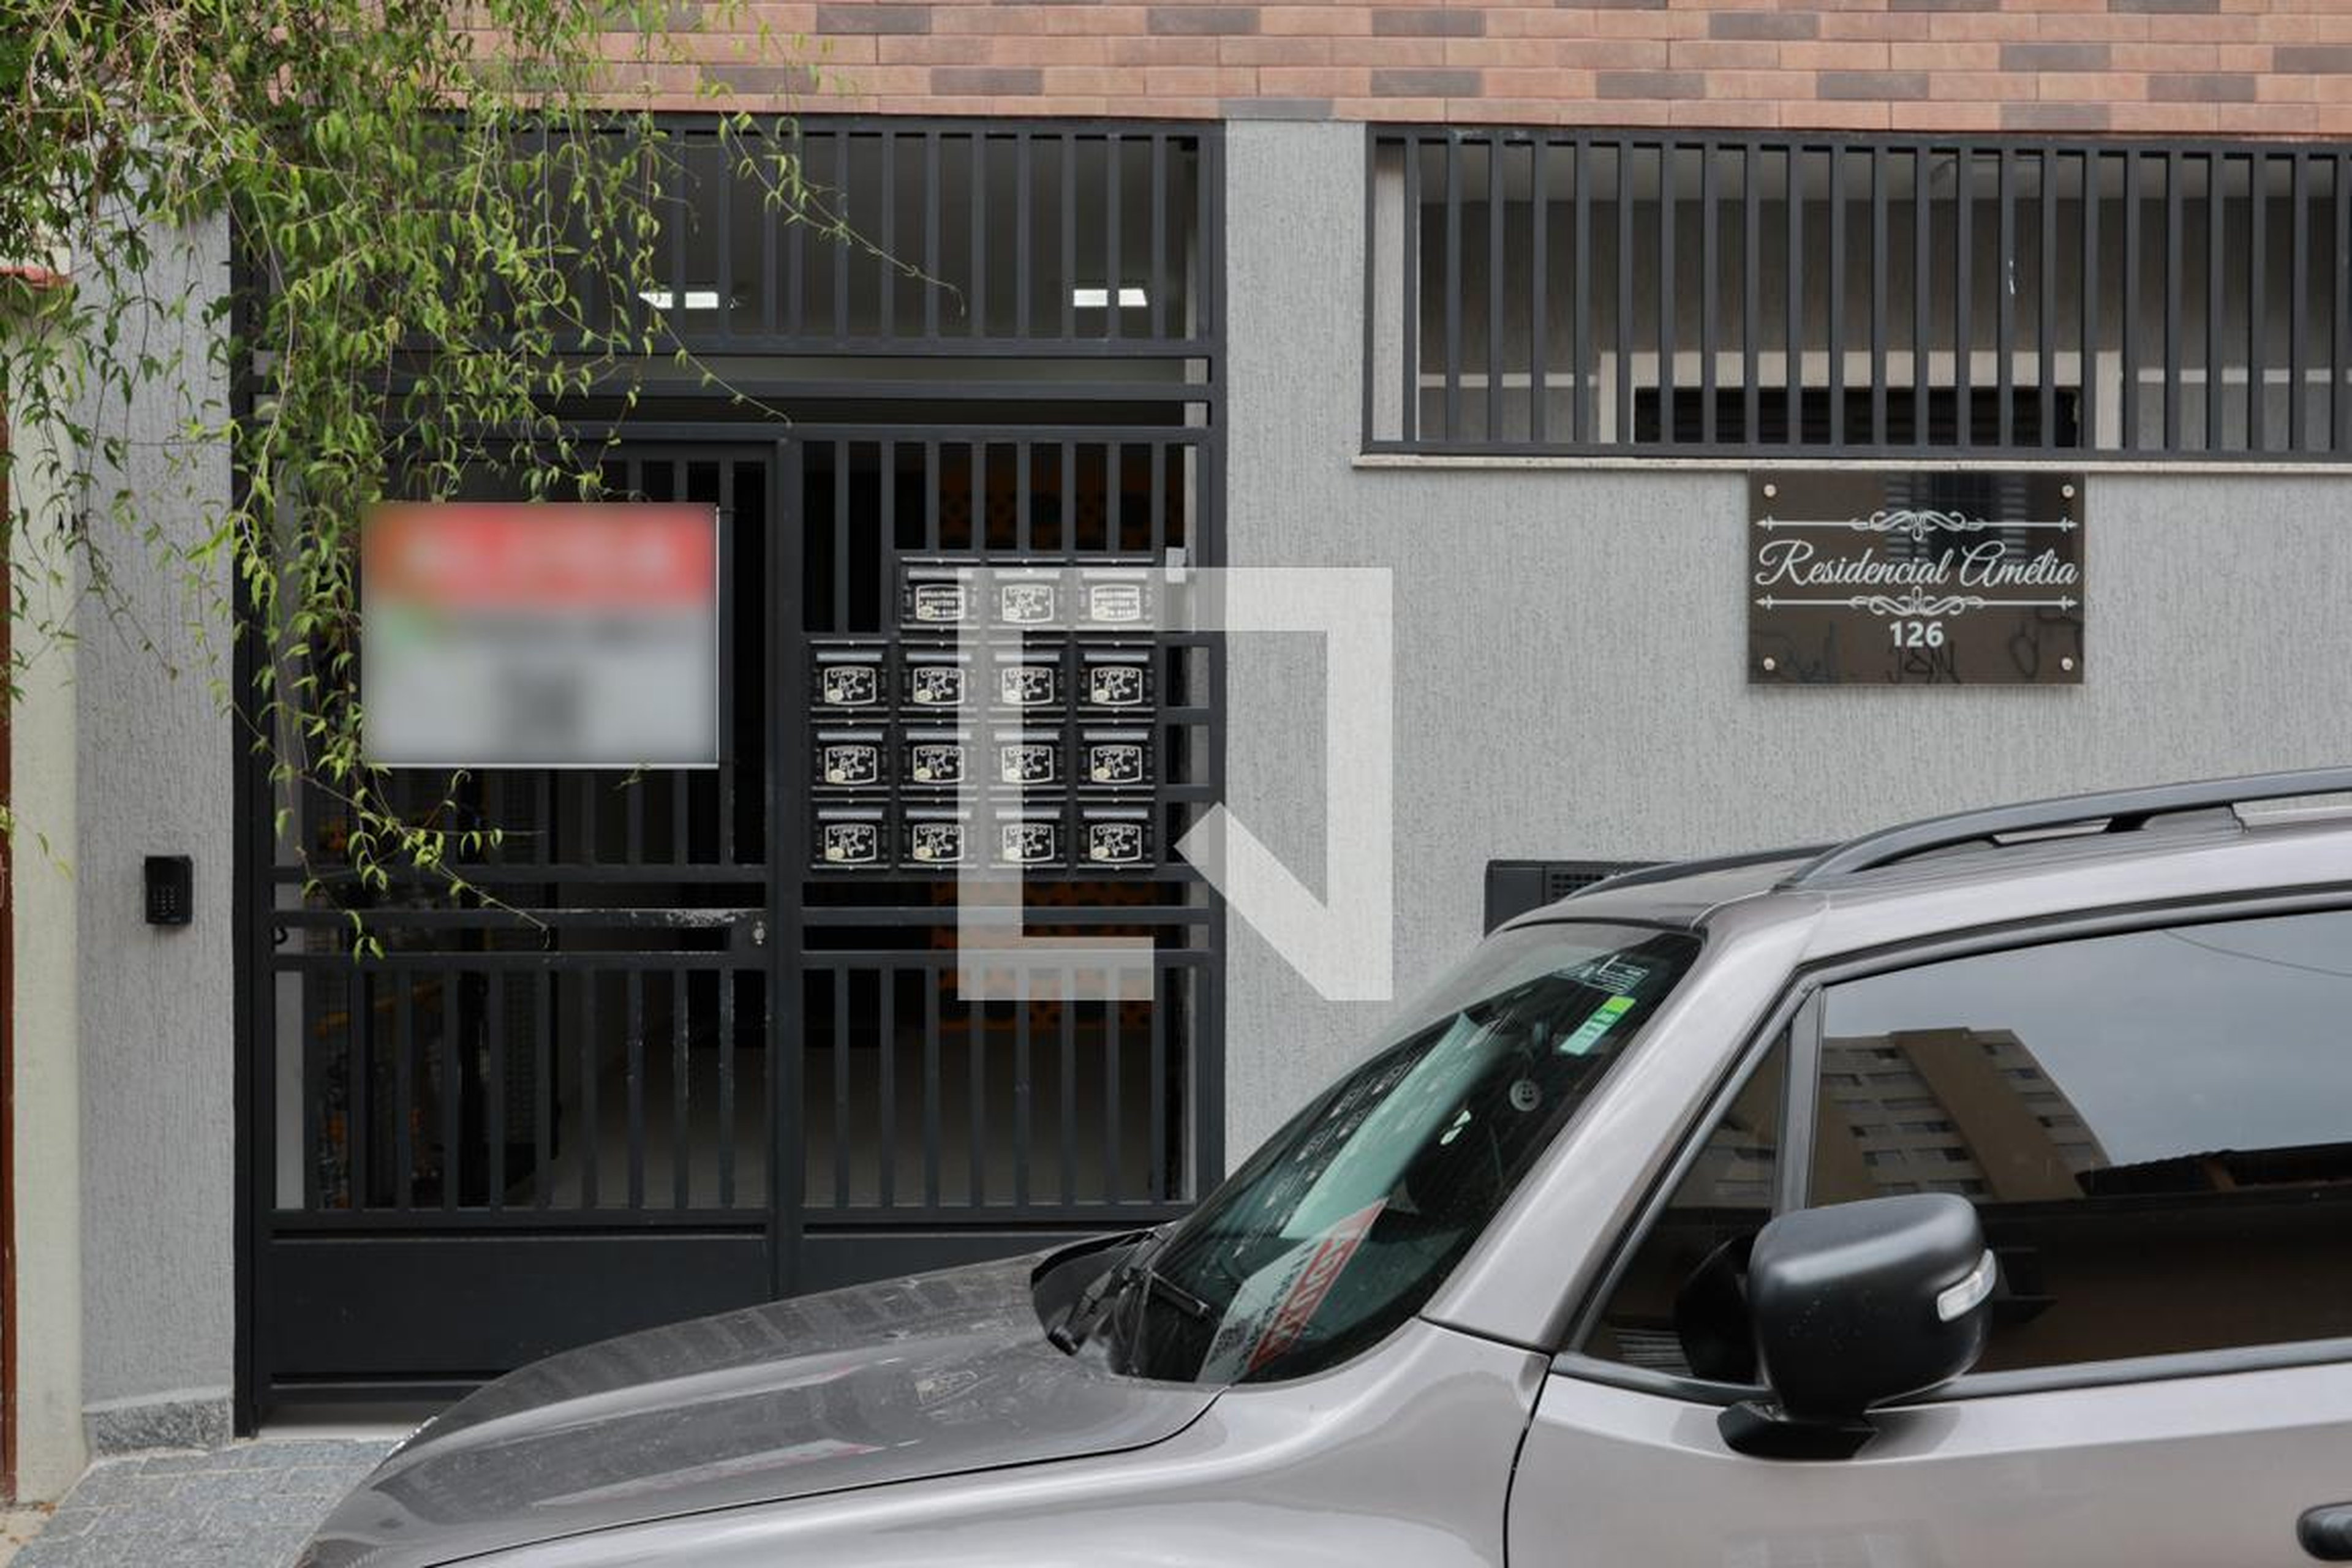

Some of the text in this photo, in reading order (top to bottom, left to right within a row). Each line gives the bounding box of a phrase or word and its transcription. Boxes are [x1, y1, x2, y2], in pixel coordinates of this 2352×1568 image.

[1754, 539, 2079, 587] Residencial Amélia
[1889, 621, 1945, 647] 126
